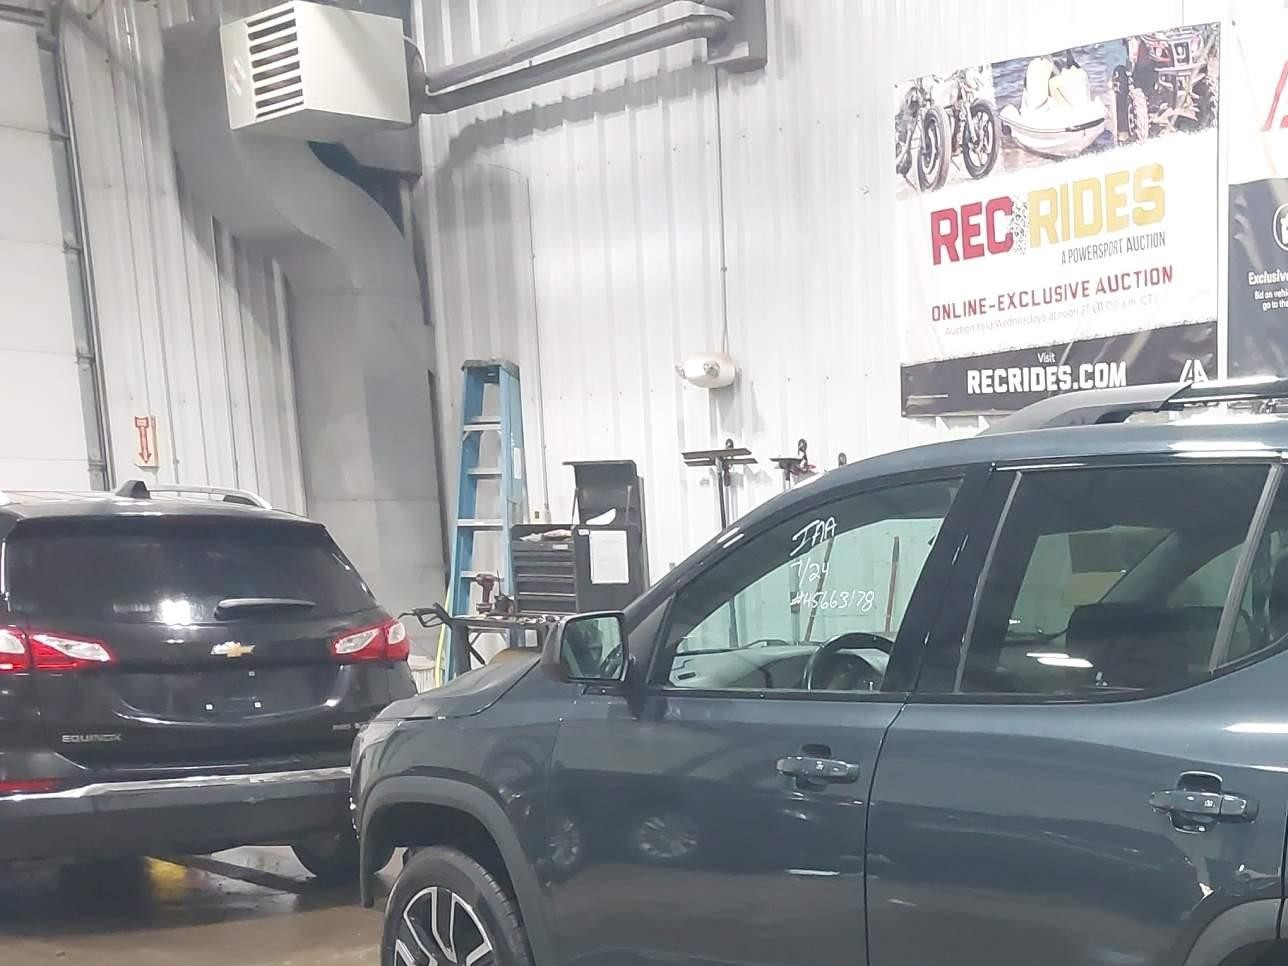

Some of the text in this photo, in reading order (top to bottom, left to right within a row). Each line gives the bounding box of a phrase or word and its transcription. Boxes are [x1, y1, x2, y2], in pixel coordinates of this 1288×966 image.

[930, 163, 1166, 265] REC RIDES
[1061, 231, 1166, 265] A POWERSPORT AUCTION
[931, 264, 1173, 322] ONLINE-EXCLUSIVE AUCTION
[1262, 301, 1271, 311] go
[1272, 300, 1278, 308] to
[1037, 352, 1056, 364] Visit
[967, 361, 1127, 395] RECRIDES.COM
[790, 516, 837, 556] IAA
[789, 557, 830, 588] 7/24
[62, 734, 122, 743] EQUINOX
